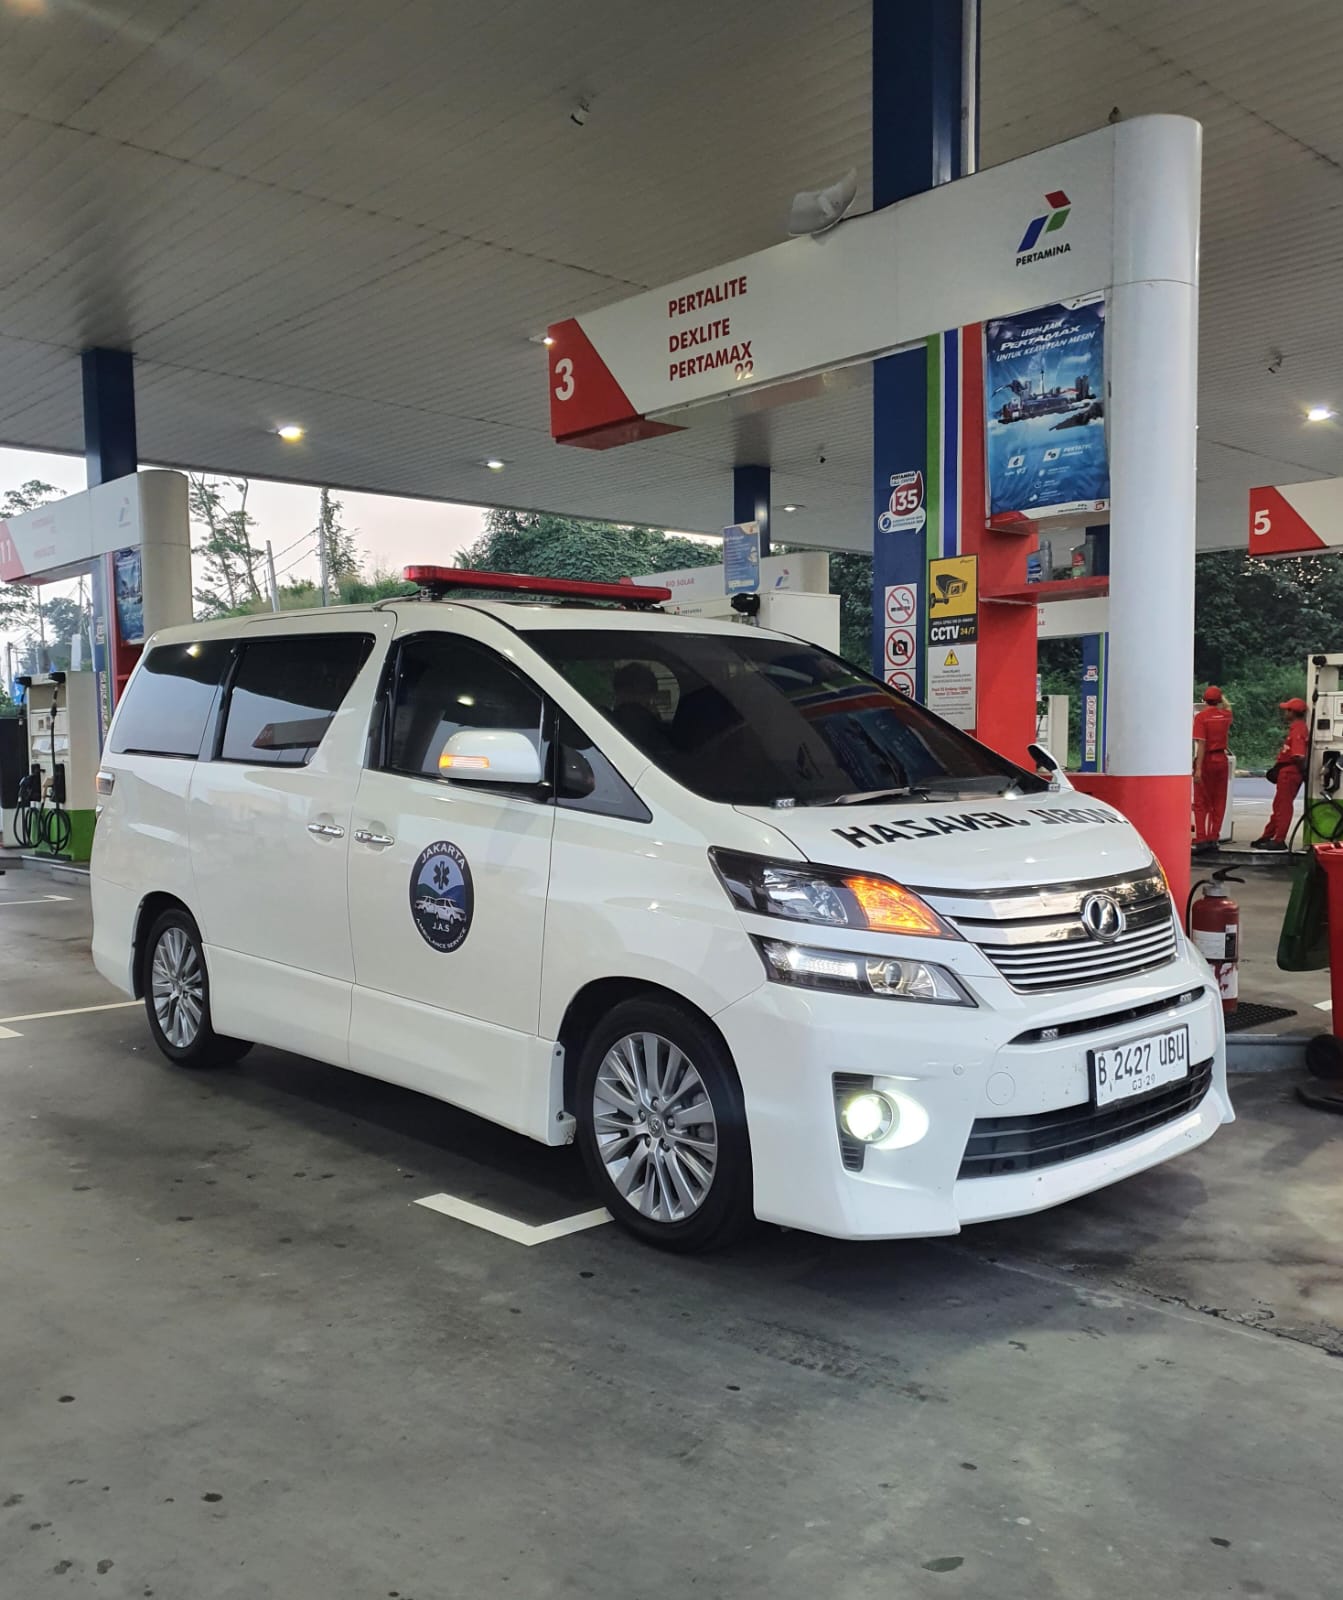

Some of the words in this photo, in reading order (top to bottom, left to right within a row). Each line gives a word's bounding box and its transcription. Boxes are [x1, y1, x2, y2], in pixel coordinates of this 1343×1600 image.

[1016, 243, 1071, 267] PERTAMINA
[669, 276, 747, 318] PERTALITE
[669, 317, 730, 353] DEXLITE
[1000, 325, 1080, 351] PERTAMAX
[669, 340, 752, 381] PERTAMAX
[996, 350, 1023, 362] UNTUK
[555, 358, 575, 401] 3
[734, 360, 754, 380] 92
[892, 489, 919, 512] 135
[1254, 509, 1271, 535] 5
[931, 625, 960, 641] CCTV
[421, 843, 465, 870] JAKARTA
[1098, 1055, 1107, 1086] B
[1114, 1043, 1151, 1080] 2427
[1159, 1033, 1185, 1066] UBU
